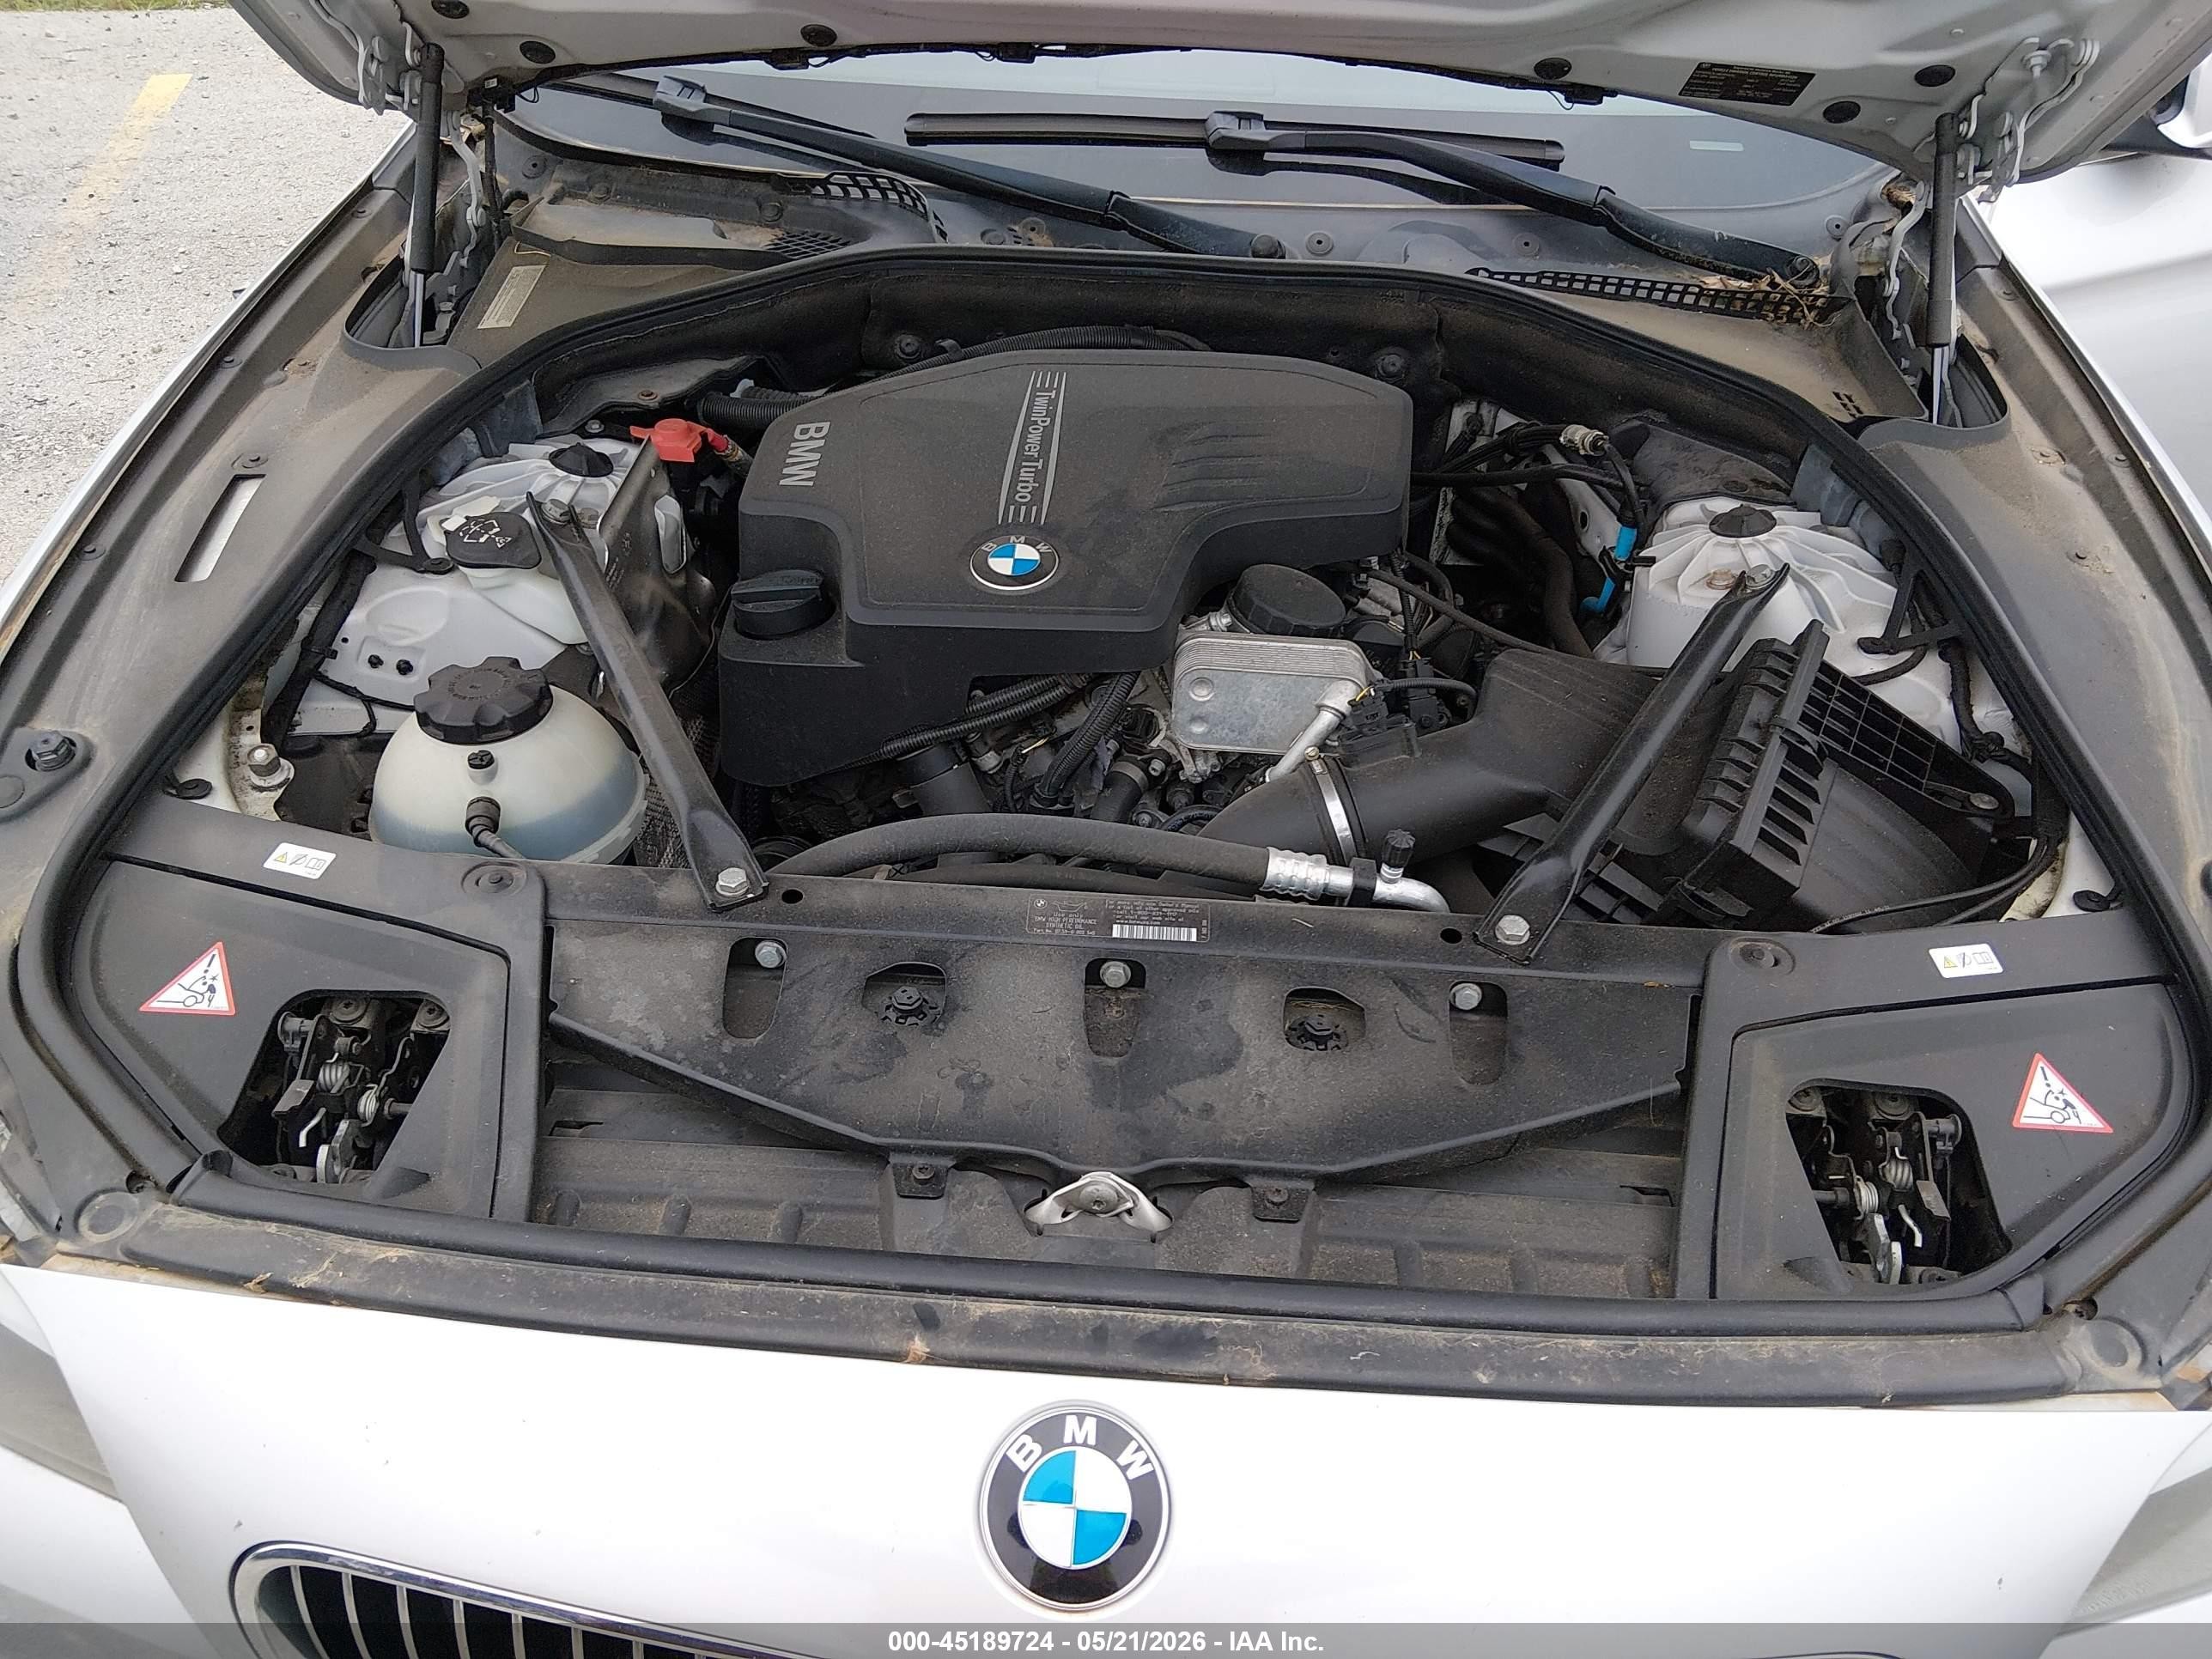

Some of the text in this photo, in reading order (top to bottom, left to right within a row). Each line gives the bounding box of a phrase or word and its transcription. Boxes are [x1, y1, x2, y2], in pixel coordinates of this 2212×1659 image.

[779, 422, 830, 486] BMW
[981, 535, 1052, 553] BMW
[1006, 1415, 1154, 1480] BMW
